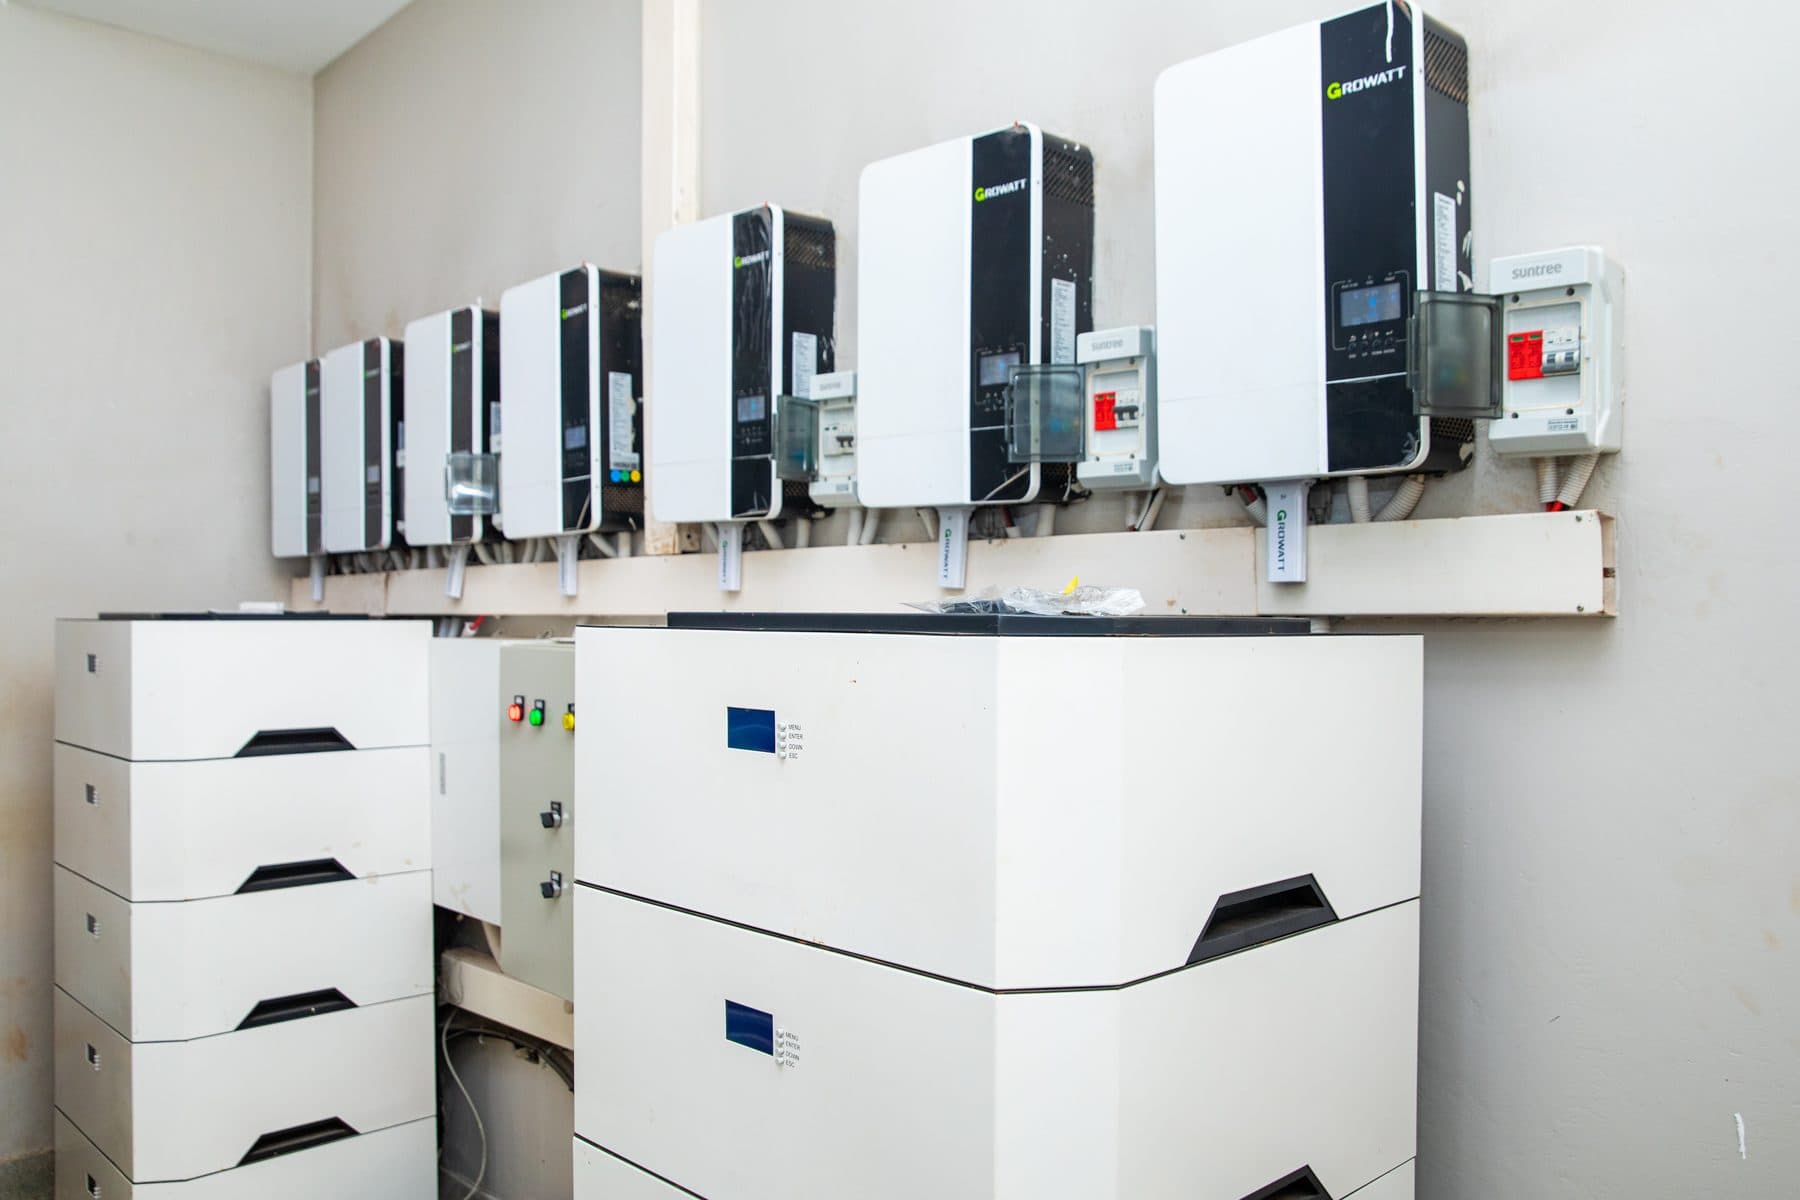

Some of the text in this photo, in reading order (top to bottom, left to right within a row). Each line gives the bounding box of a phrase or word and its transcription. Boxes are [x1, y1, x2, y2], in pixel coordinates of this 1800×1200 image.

[1326, 65, 1407, 100] GROWATT
[974, 178, 1027, 202] GROWATT
[1511, 263, 1562, 280] suntree
[1277, 509, 1287, 572] GROWATT
[785, 1060, 795, 1068] ESC
